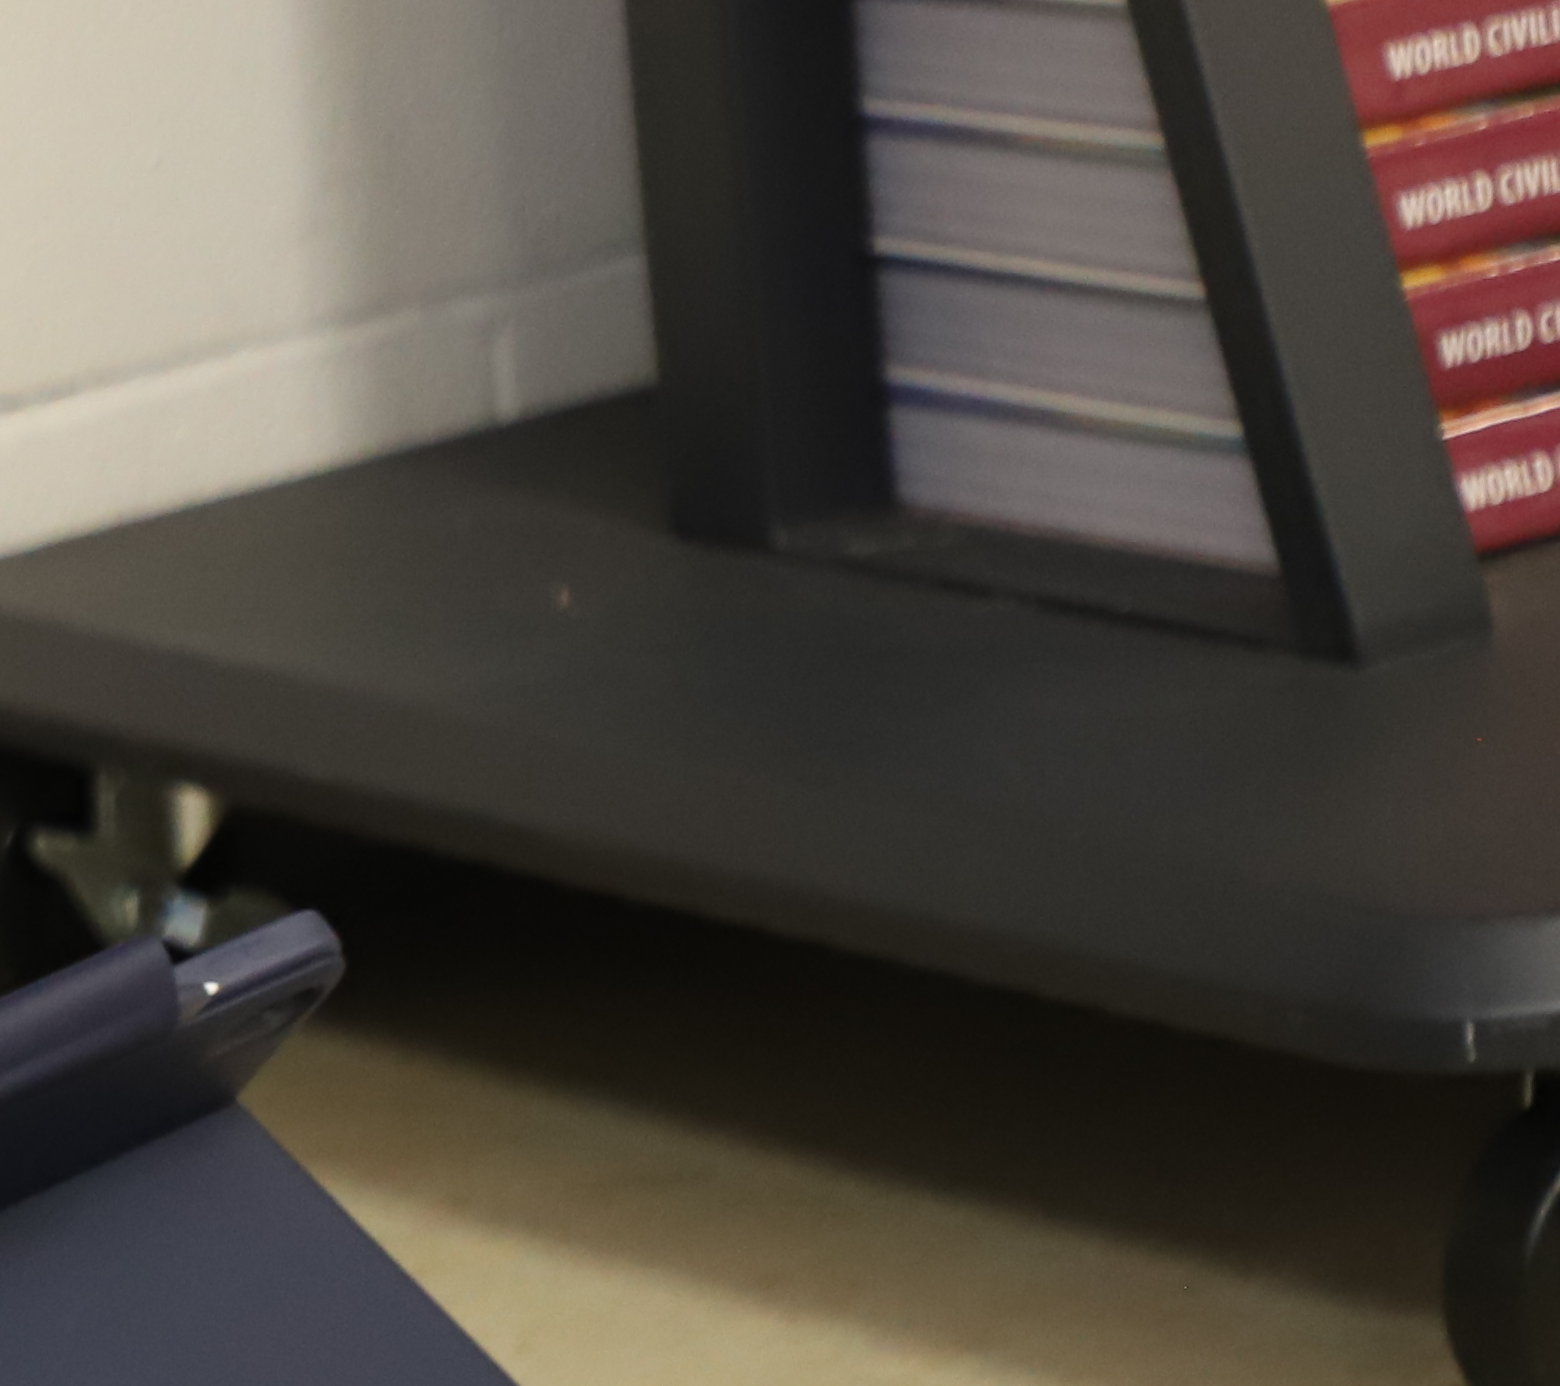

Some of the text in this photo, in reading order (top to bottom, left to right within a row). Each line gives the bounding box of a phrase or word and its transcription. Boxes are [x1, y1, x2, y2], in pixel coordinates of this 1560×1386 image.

[1386, 25, 1481, 82] WORLD
[1398, 171, 1494, 231] WORLD
[1438, 310, 1534, 368] WORLD
[1458, 452, 1555, 512] WORLD
